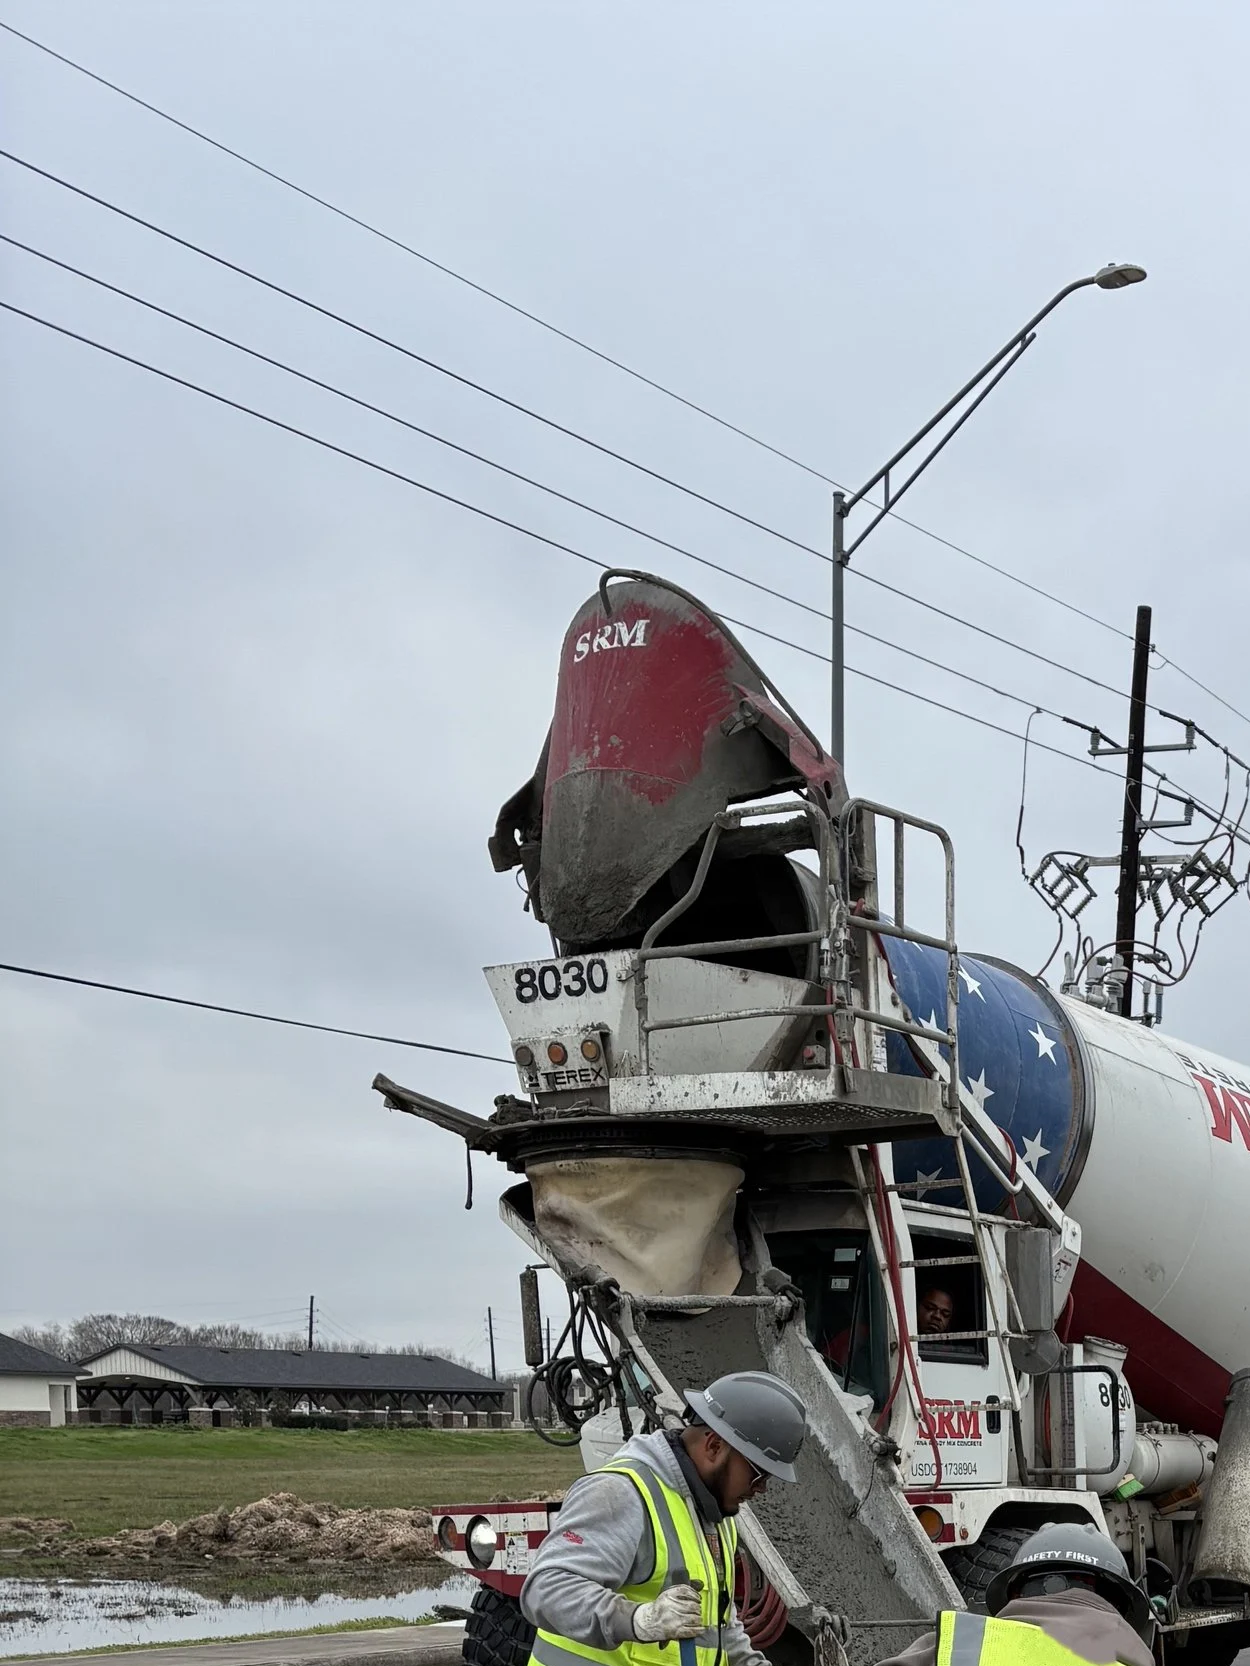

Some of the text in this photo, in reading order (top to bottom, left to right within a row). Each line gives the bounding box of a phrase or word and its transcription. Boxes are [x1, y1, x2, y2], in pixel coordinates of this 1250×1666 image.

[573, 619, 651, 663] SRM
[514, 958, 609, 1004] 8030
[540, 1066, 606, 1086] TEREX
[1098, 1382, 1131, 1409] 830
[944, 1462, 977, 1476] 1738904
[1065, 1551, 1099, 1566] FIRST
